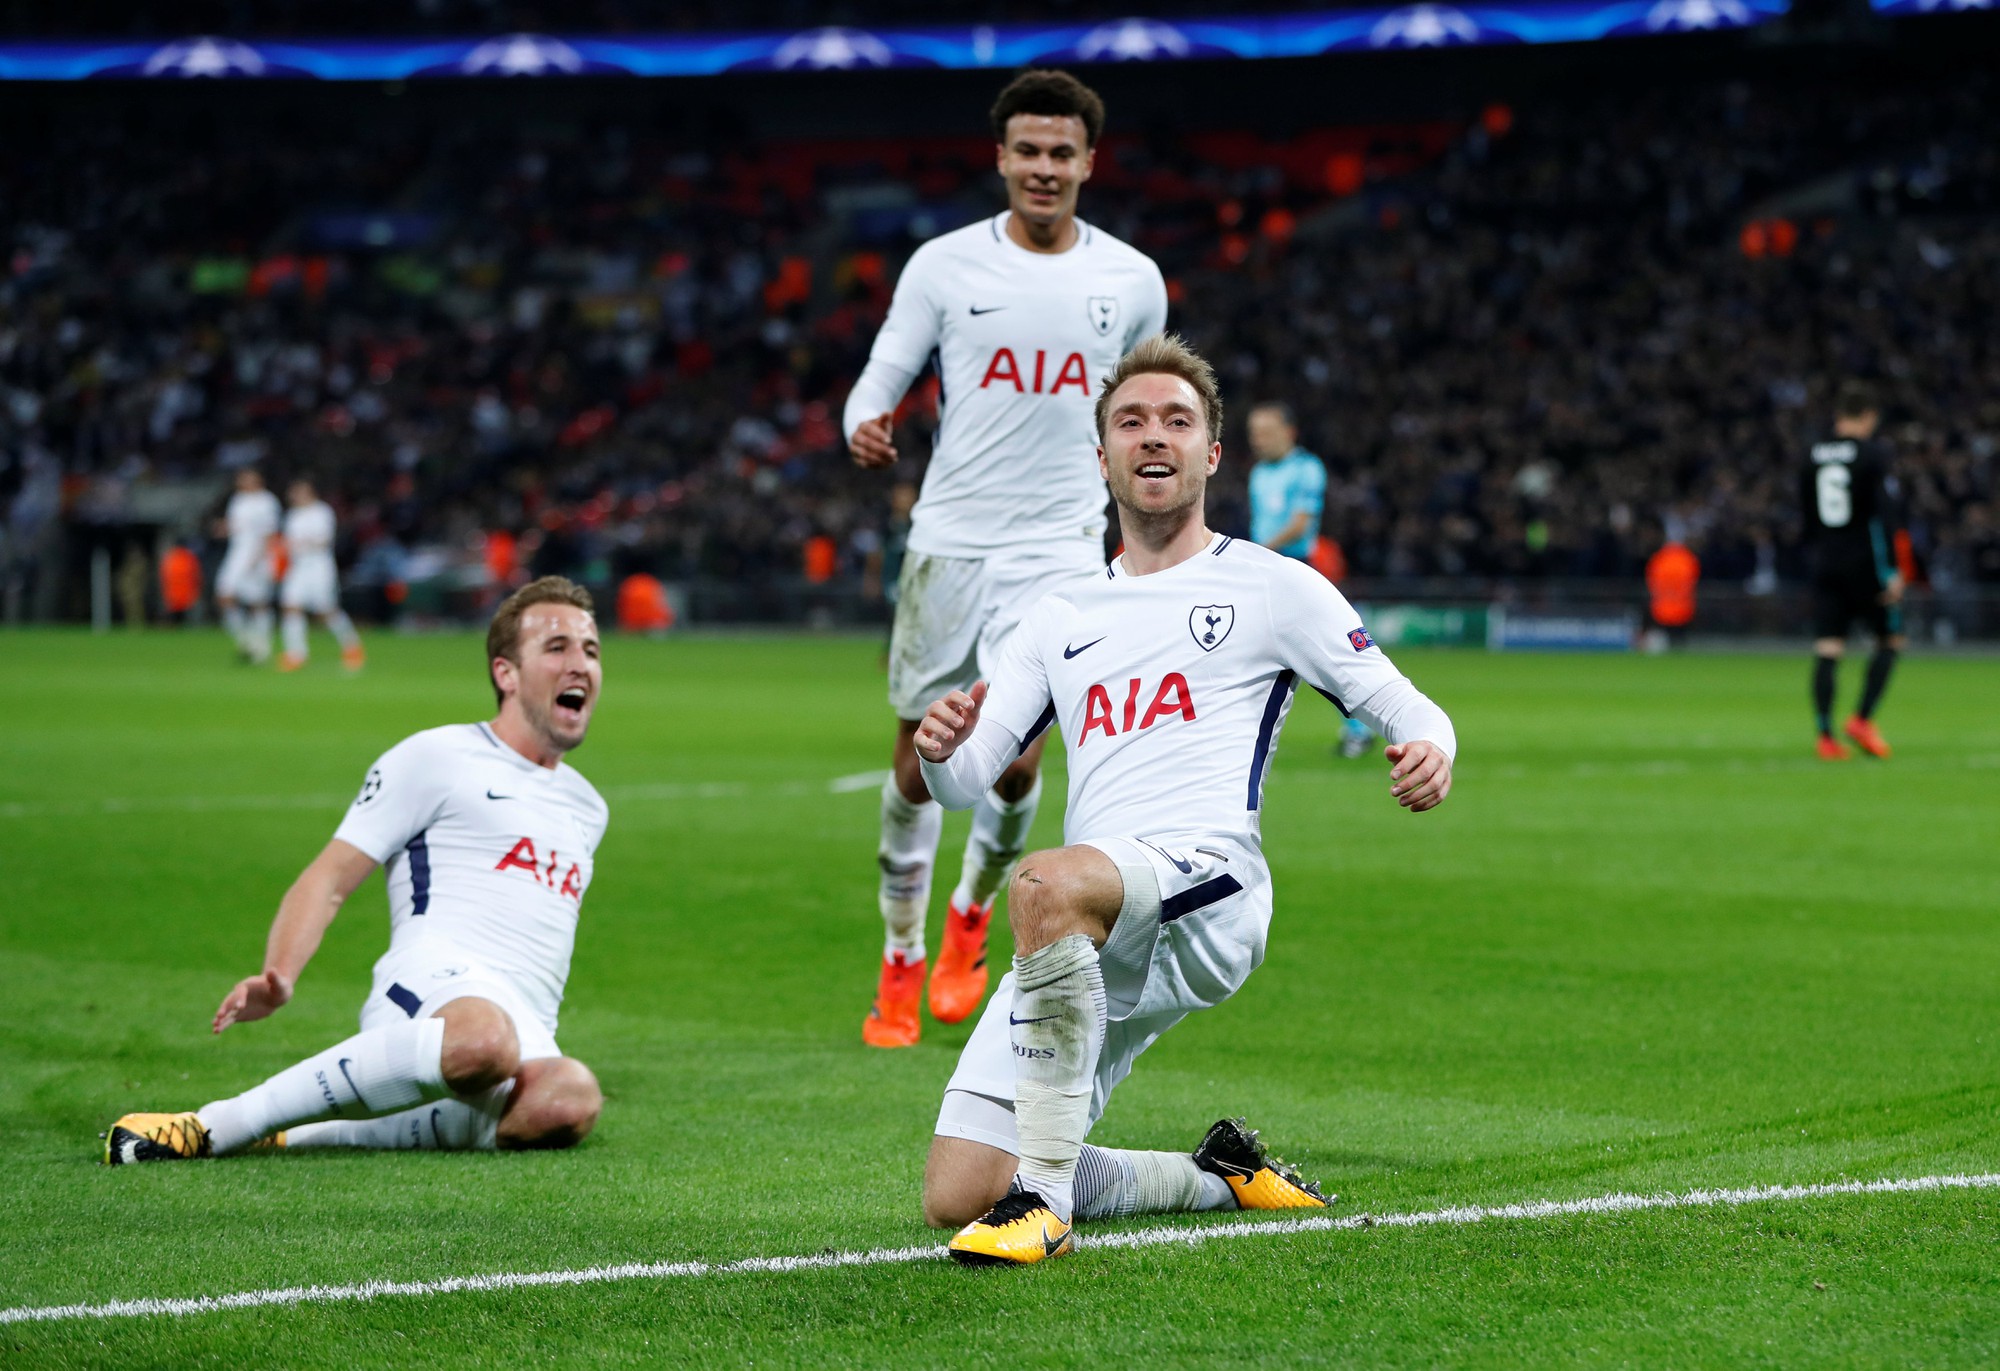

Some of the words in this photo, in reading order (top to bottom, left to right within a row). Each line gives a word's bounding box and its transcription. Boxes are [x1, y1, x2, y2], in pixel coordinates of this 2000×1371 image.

[980, 347, 1090, 396] AIA
[1816, 464, 1852, 528] 6
[1077, 672, 1196, 748] AIA
[494, 837, 581, 903] AIA
